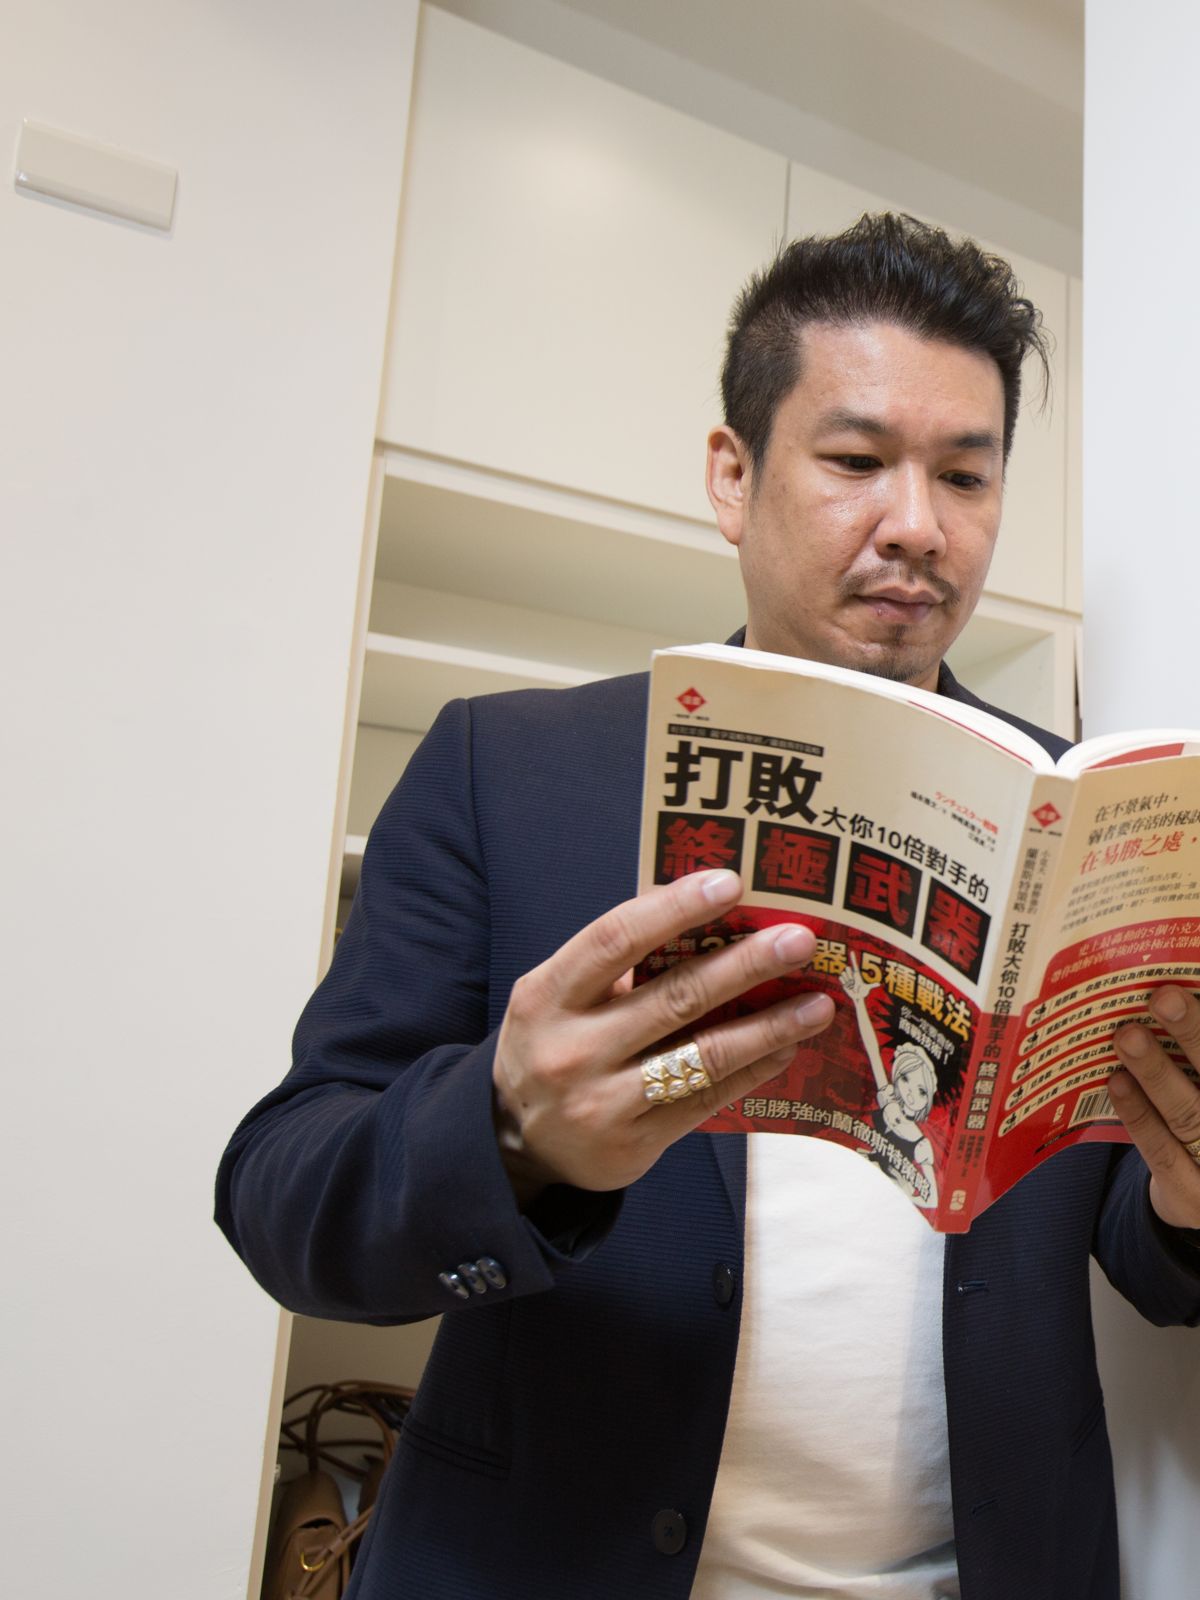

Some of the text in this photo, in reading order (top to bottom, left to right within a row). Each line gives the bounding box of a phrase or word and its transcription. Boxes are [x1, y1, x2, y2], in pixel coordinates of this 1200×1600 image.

[664, 741, 822, 824] 打敗
[660, 815, 986, 980] 終極武器
[821, 807, 989, 904] 大你10倍對手的
[712, 1098, 933, 1203] 、弱勝強的蘭徹斯特策略
